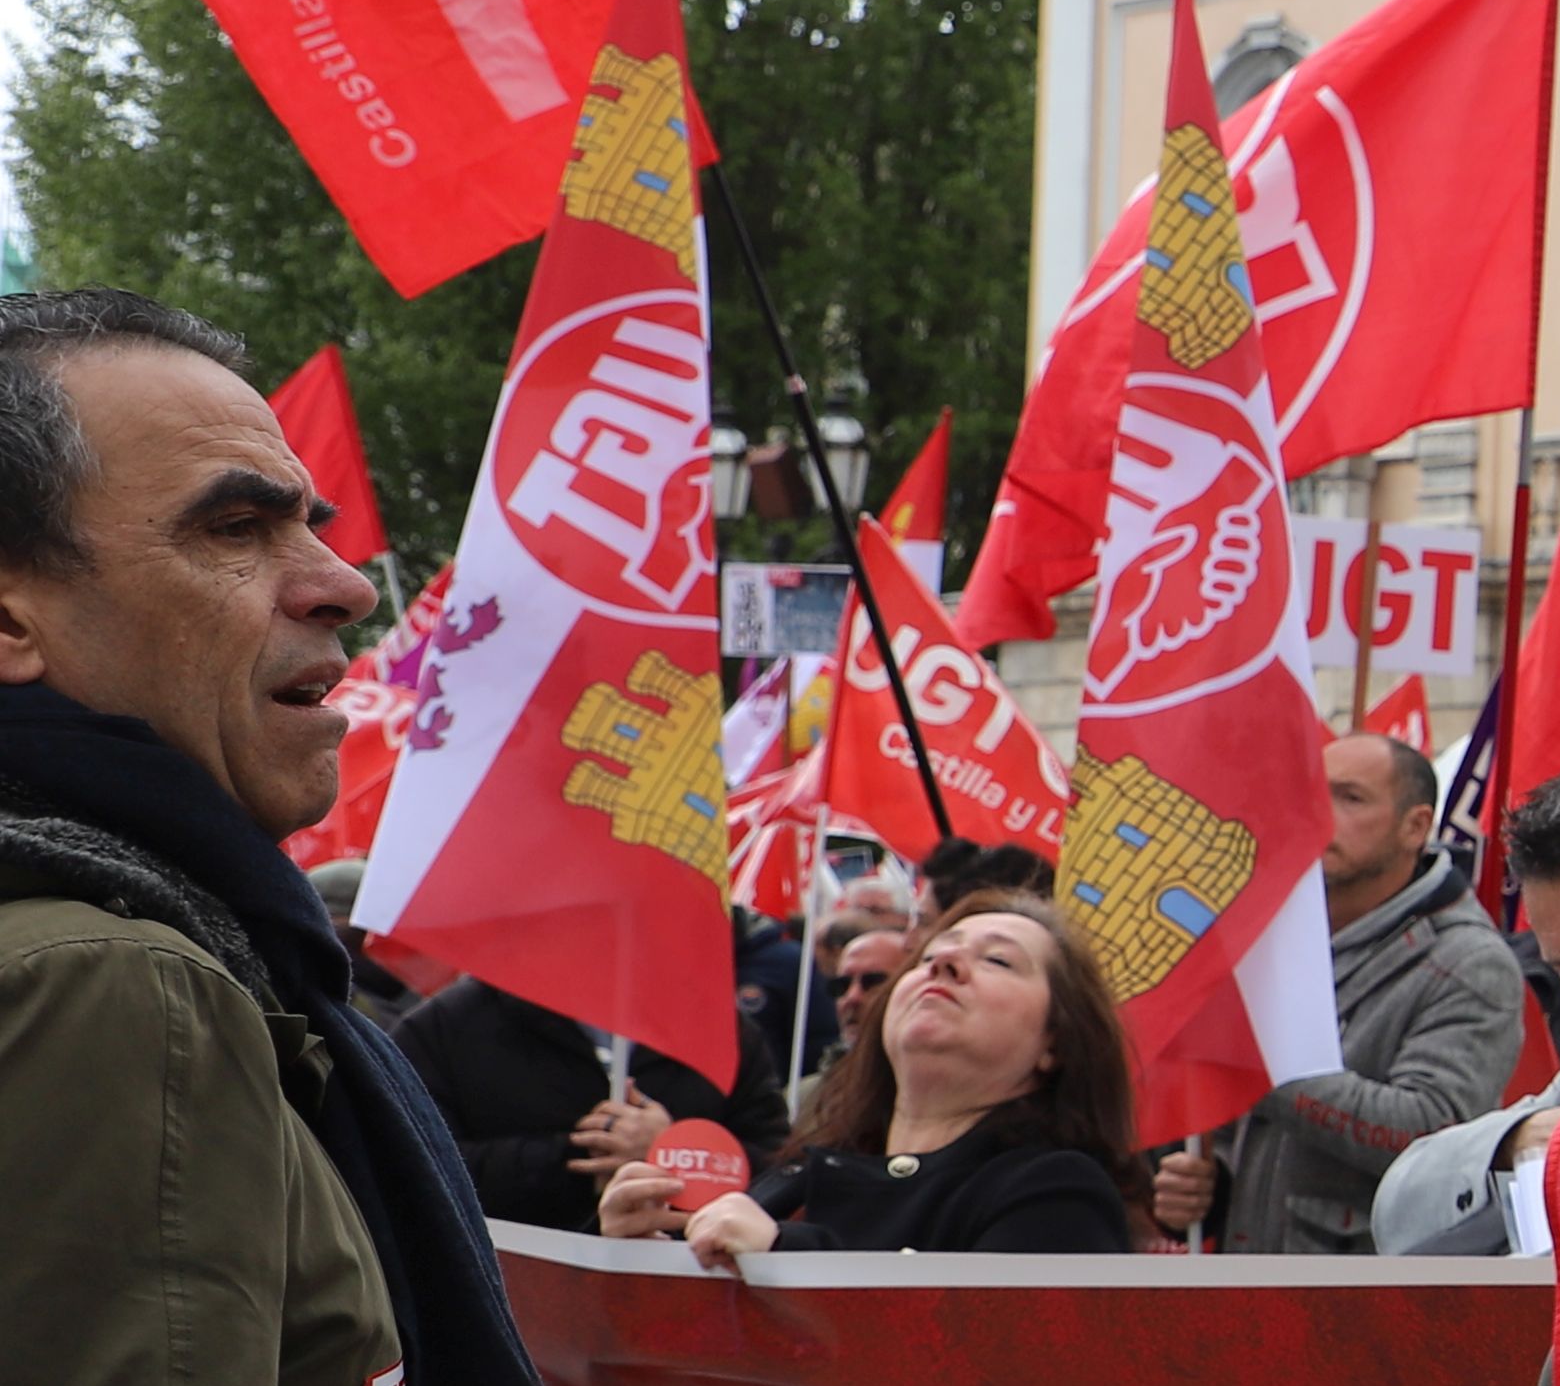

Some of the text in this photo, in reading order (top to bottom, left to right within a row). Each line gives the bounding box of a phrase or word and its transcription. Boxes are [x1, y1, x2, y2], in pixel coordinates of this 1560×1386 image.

[845, 604, 1016, 754] UGT
[1003, 797, 1038, 831] y
[656, 1148, 710, 1170] UGT
